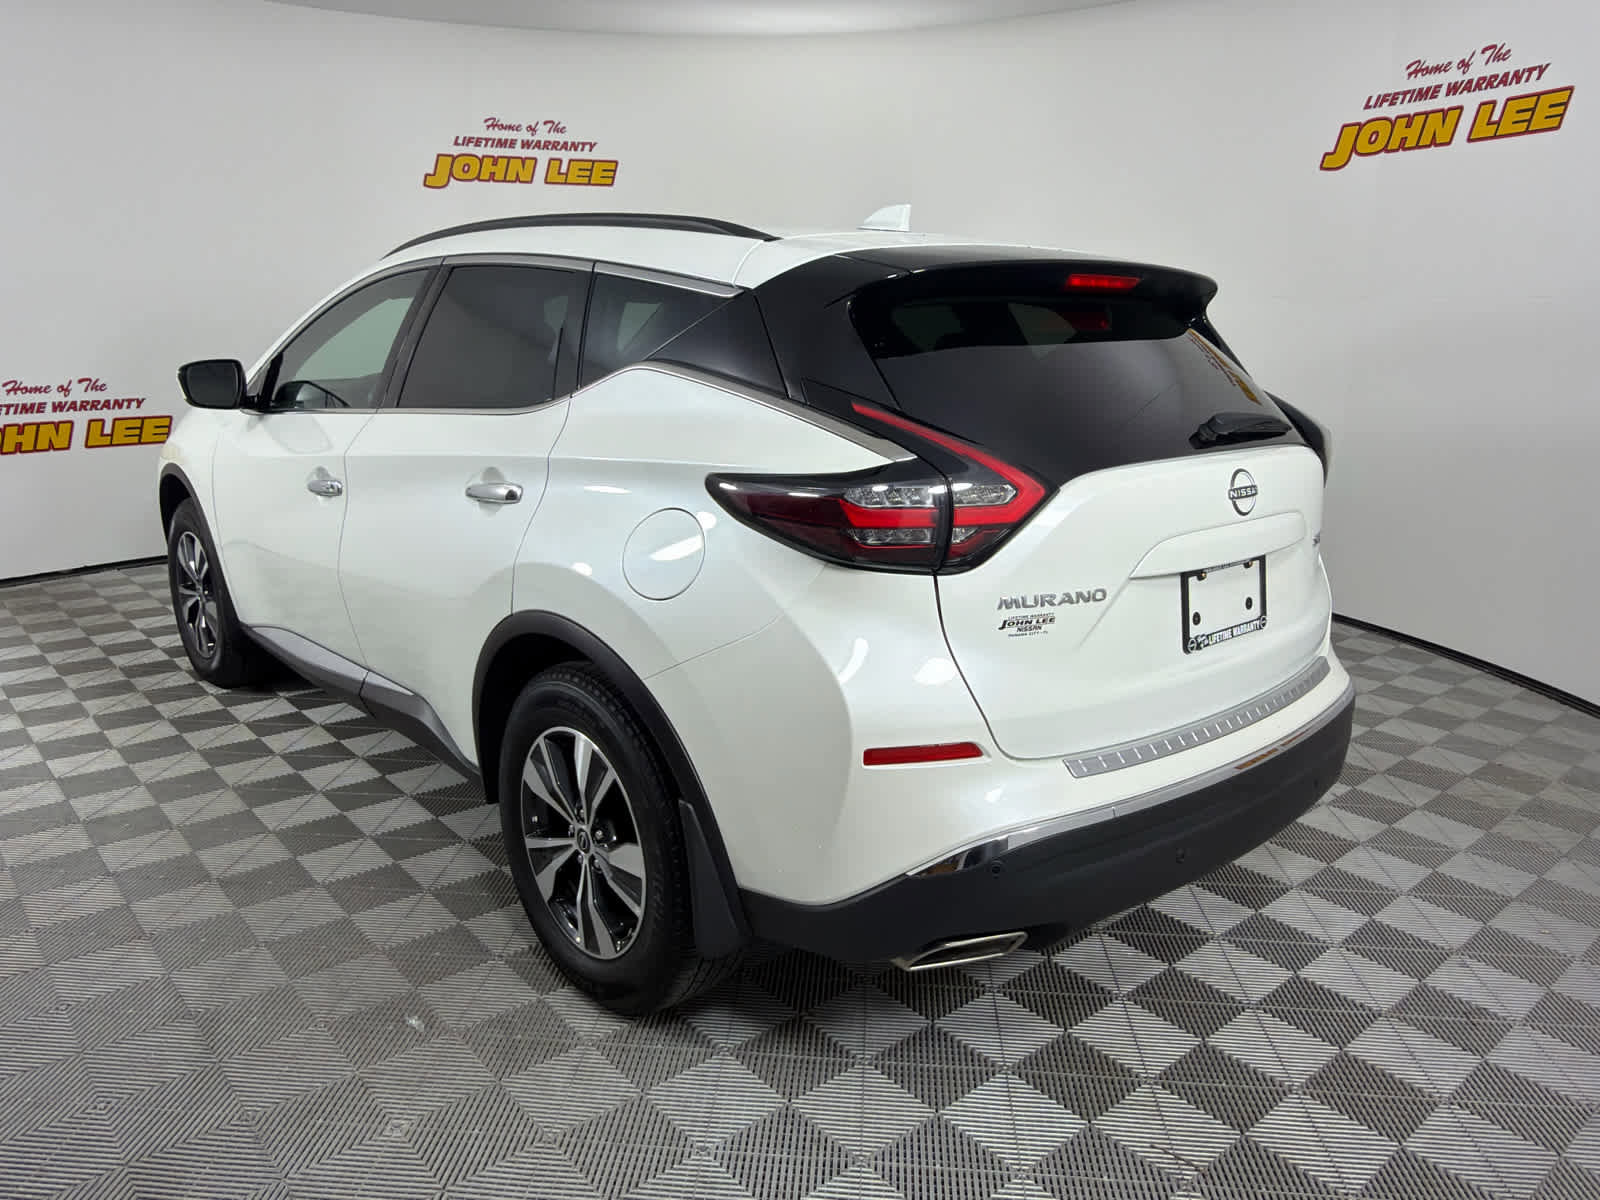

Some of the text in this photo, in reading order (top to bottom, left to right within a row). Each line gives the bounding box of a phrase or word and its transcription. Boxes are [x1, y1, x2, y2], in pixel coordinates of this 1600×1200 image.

[1405, 42, 1512, 80] Home of The
[1363, 63, 1551, 110] LIFETIME WARRANTY
[484, 117, 567, 137] Home of The
[1319, 85, 1576, 171] JOHN LEE
[453, 136, 598, 153] LIFETIME WARRANTY
[423, 153, 619, 190] JOHN LEE
[2, 377, 108, 398] Home of The
[0, 398, 146, 416] TIME WARRANTY
[0, 415, 173, 456] HN LEE
[997, 588, 1108, 611] MURANO
[998, 616, 1056, 630] JOHN LEE
